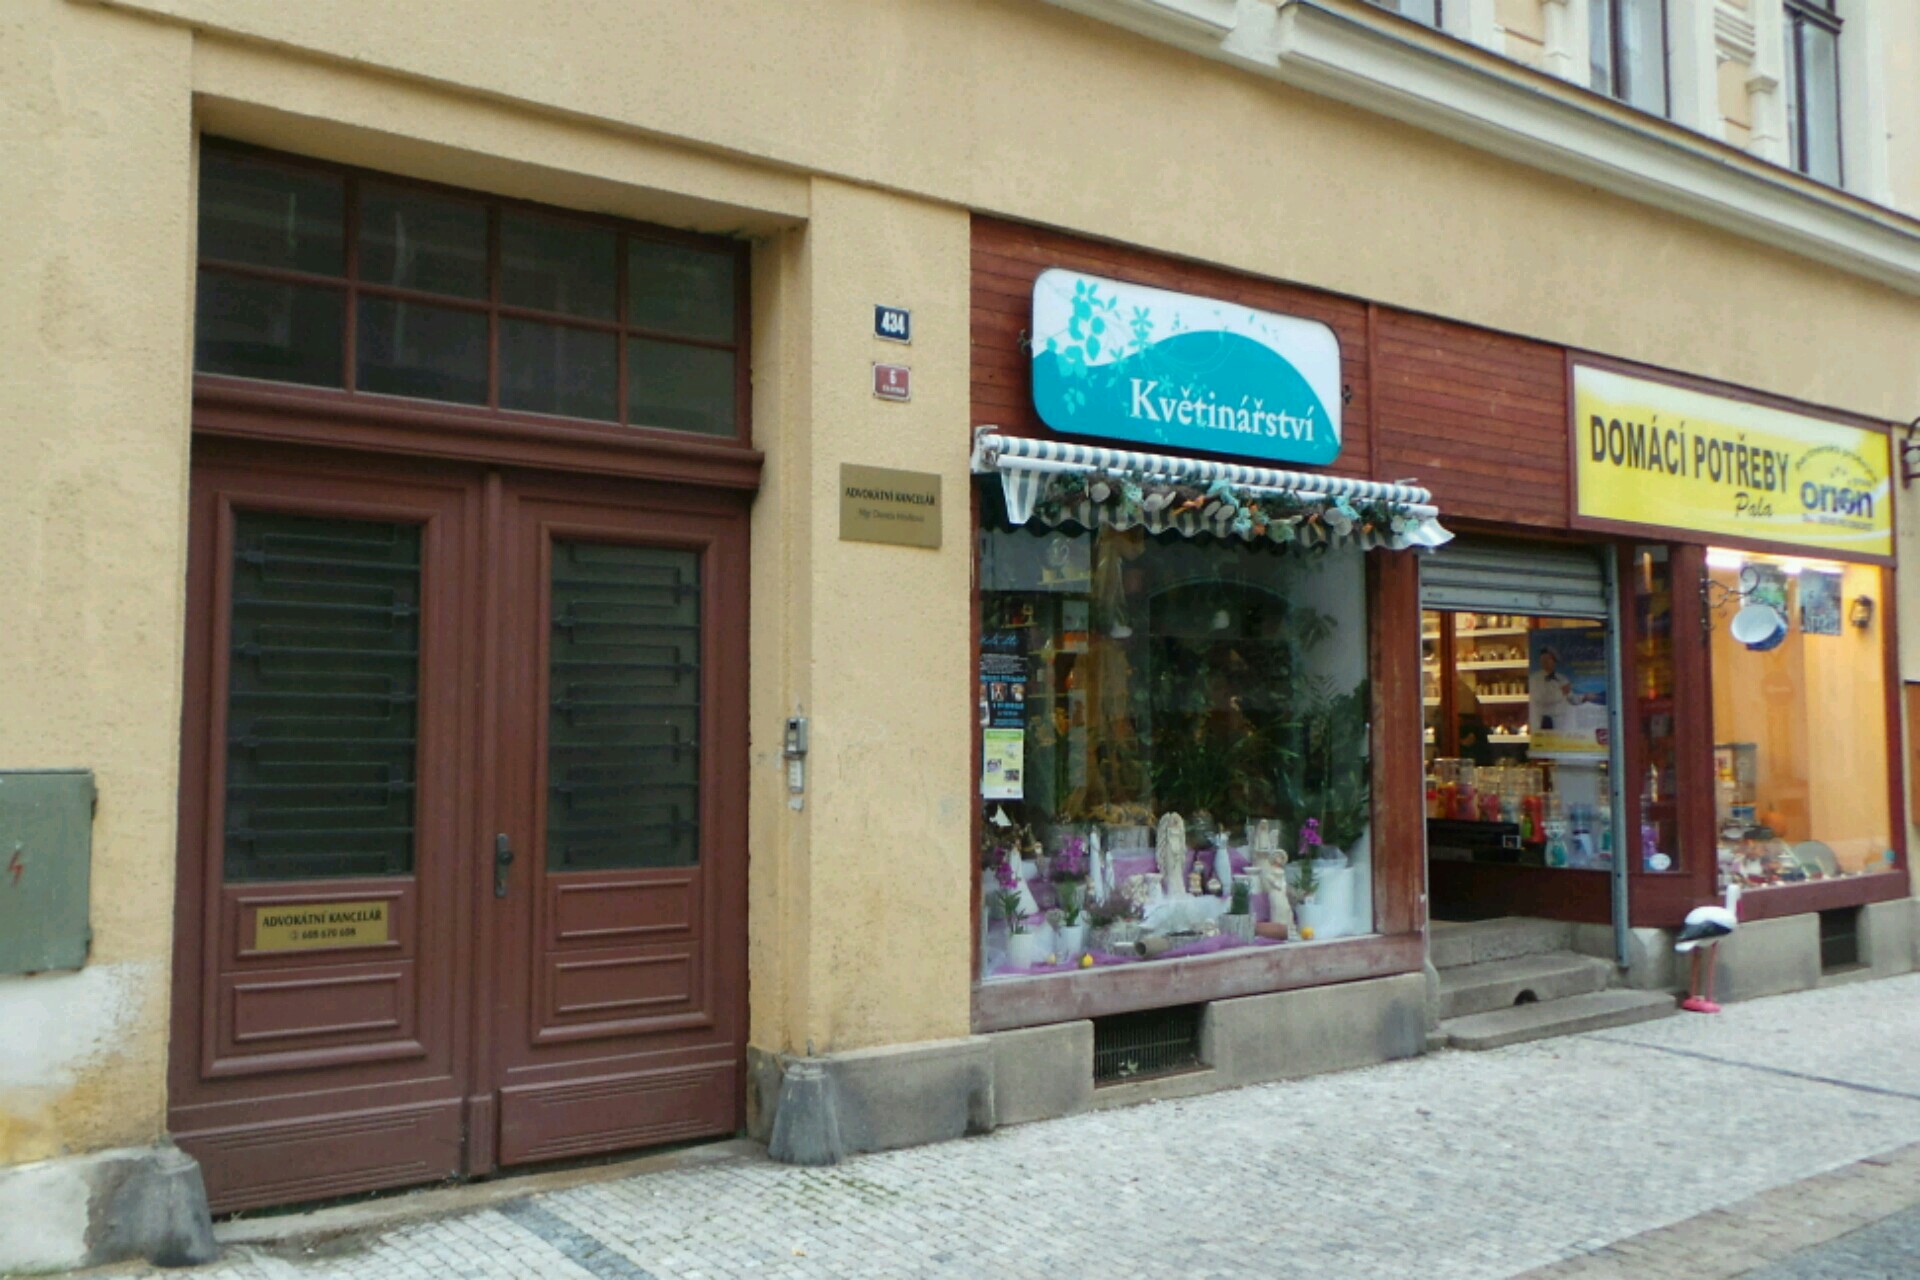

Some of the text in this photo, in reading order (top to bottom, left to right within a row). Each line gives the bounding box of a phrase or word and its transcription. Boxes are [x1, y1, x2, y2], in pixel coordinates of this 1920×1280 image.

[881, 311, 905, 335] 434
[1129, 377, 1315, 442] Květinářství
[1590, 414, 1686, 477] DOMÁCÍ
[1694, 432, 1789, 494] POTŘEBY
[263, 907, 382, 927] ADVOKÁTNÍ KANCELÁŘ
